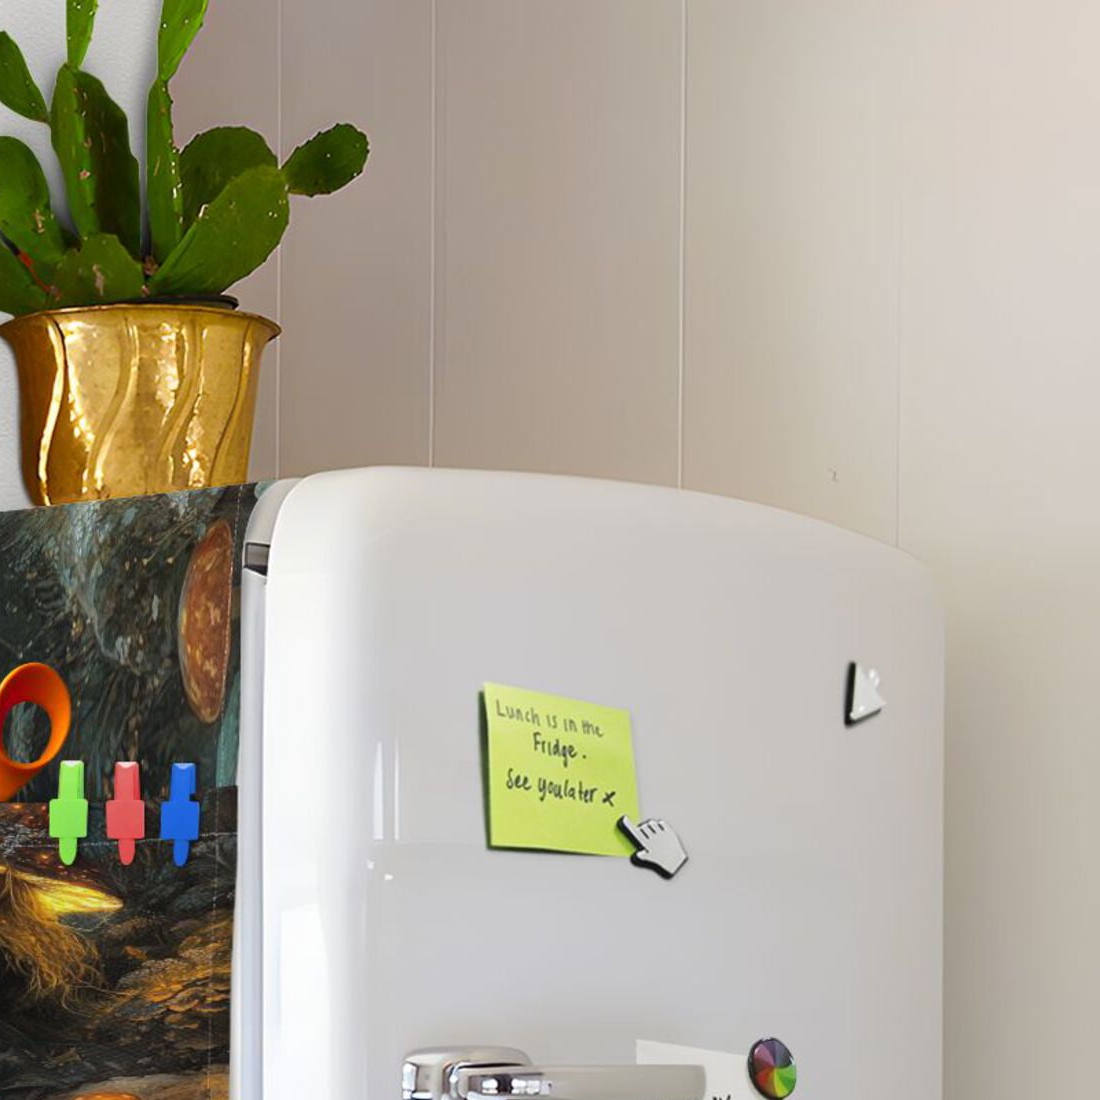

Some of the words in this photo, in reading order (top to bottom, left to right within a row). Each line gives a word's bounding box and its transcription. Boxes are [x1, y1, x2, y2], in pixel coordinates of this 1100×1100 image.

[495, 699, 540, 727] Lunch
[582, 718, 604, 738] the
[505, 767, 532, 790] See
